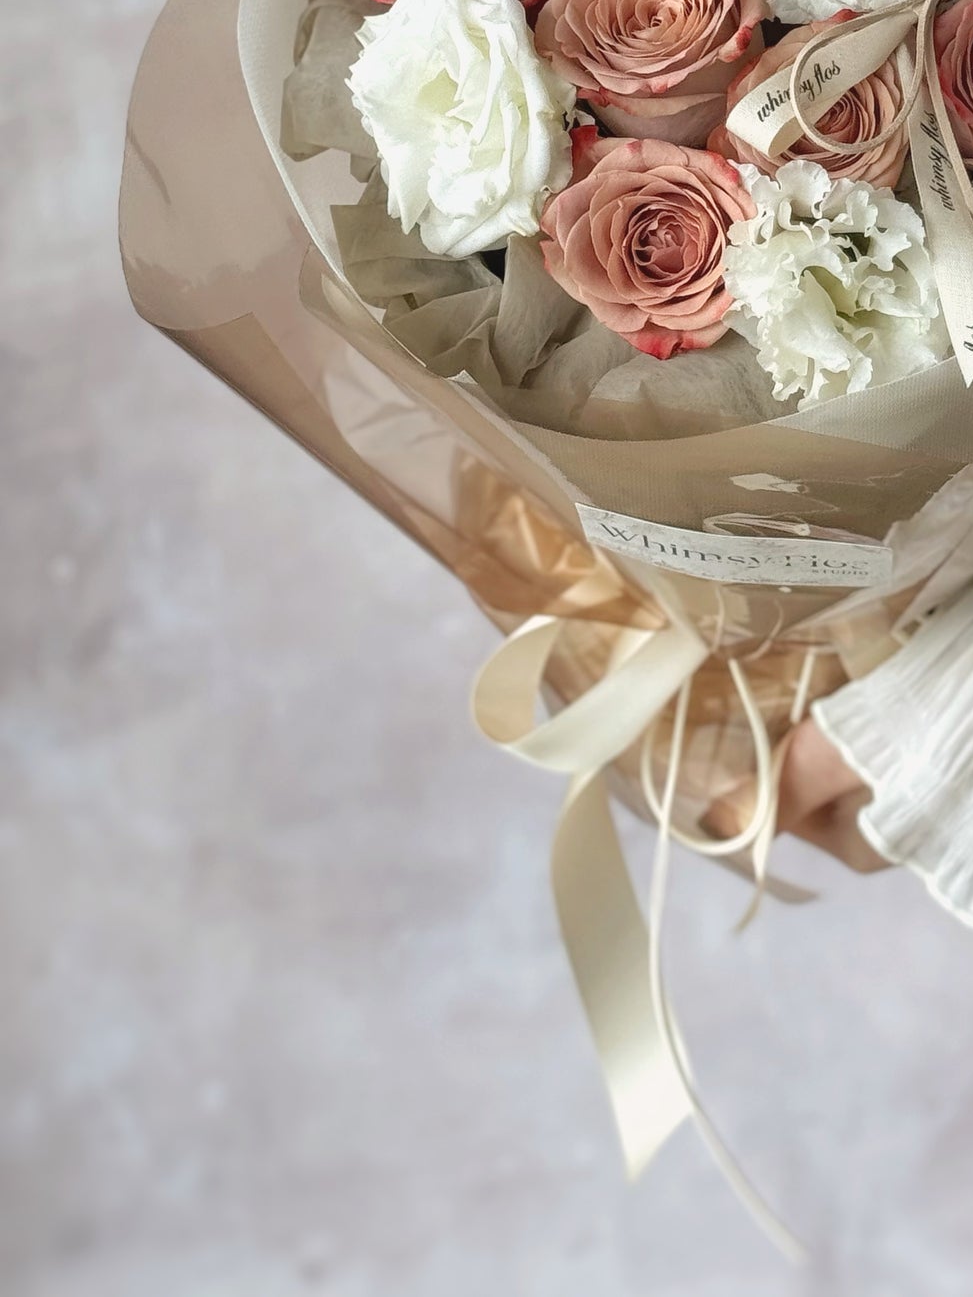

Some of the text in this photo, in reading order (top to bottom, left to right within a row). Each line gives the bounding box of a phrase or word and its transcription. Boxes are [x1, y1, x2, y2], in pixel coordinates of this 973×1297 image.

[813, 60, 841, 95] flos
[920, 109, 956, 212] whimsy flos
[599, 522, 772, 569] Whimsy
